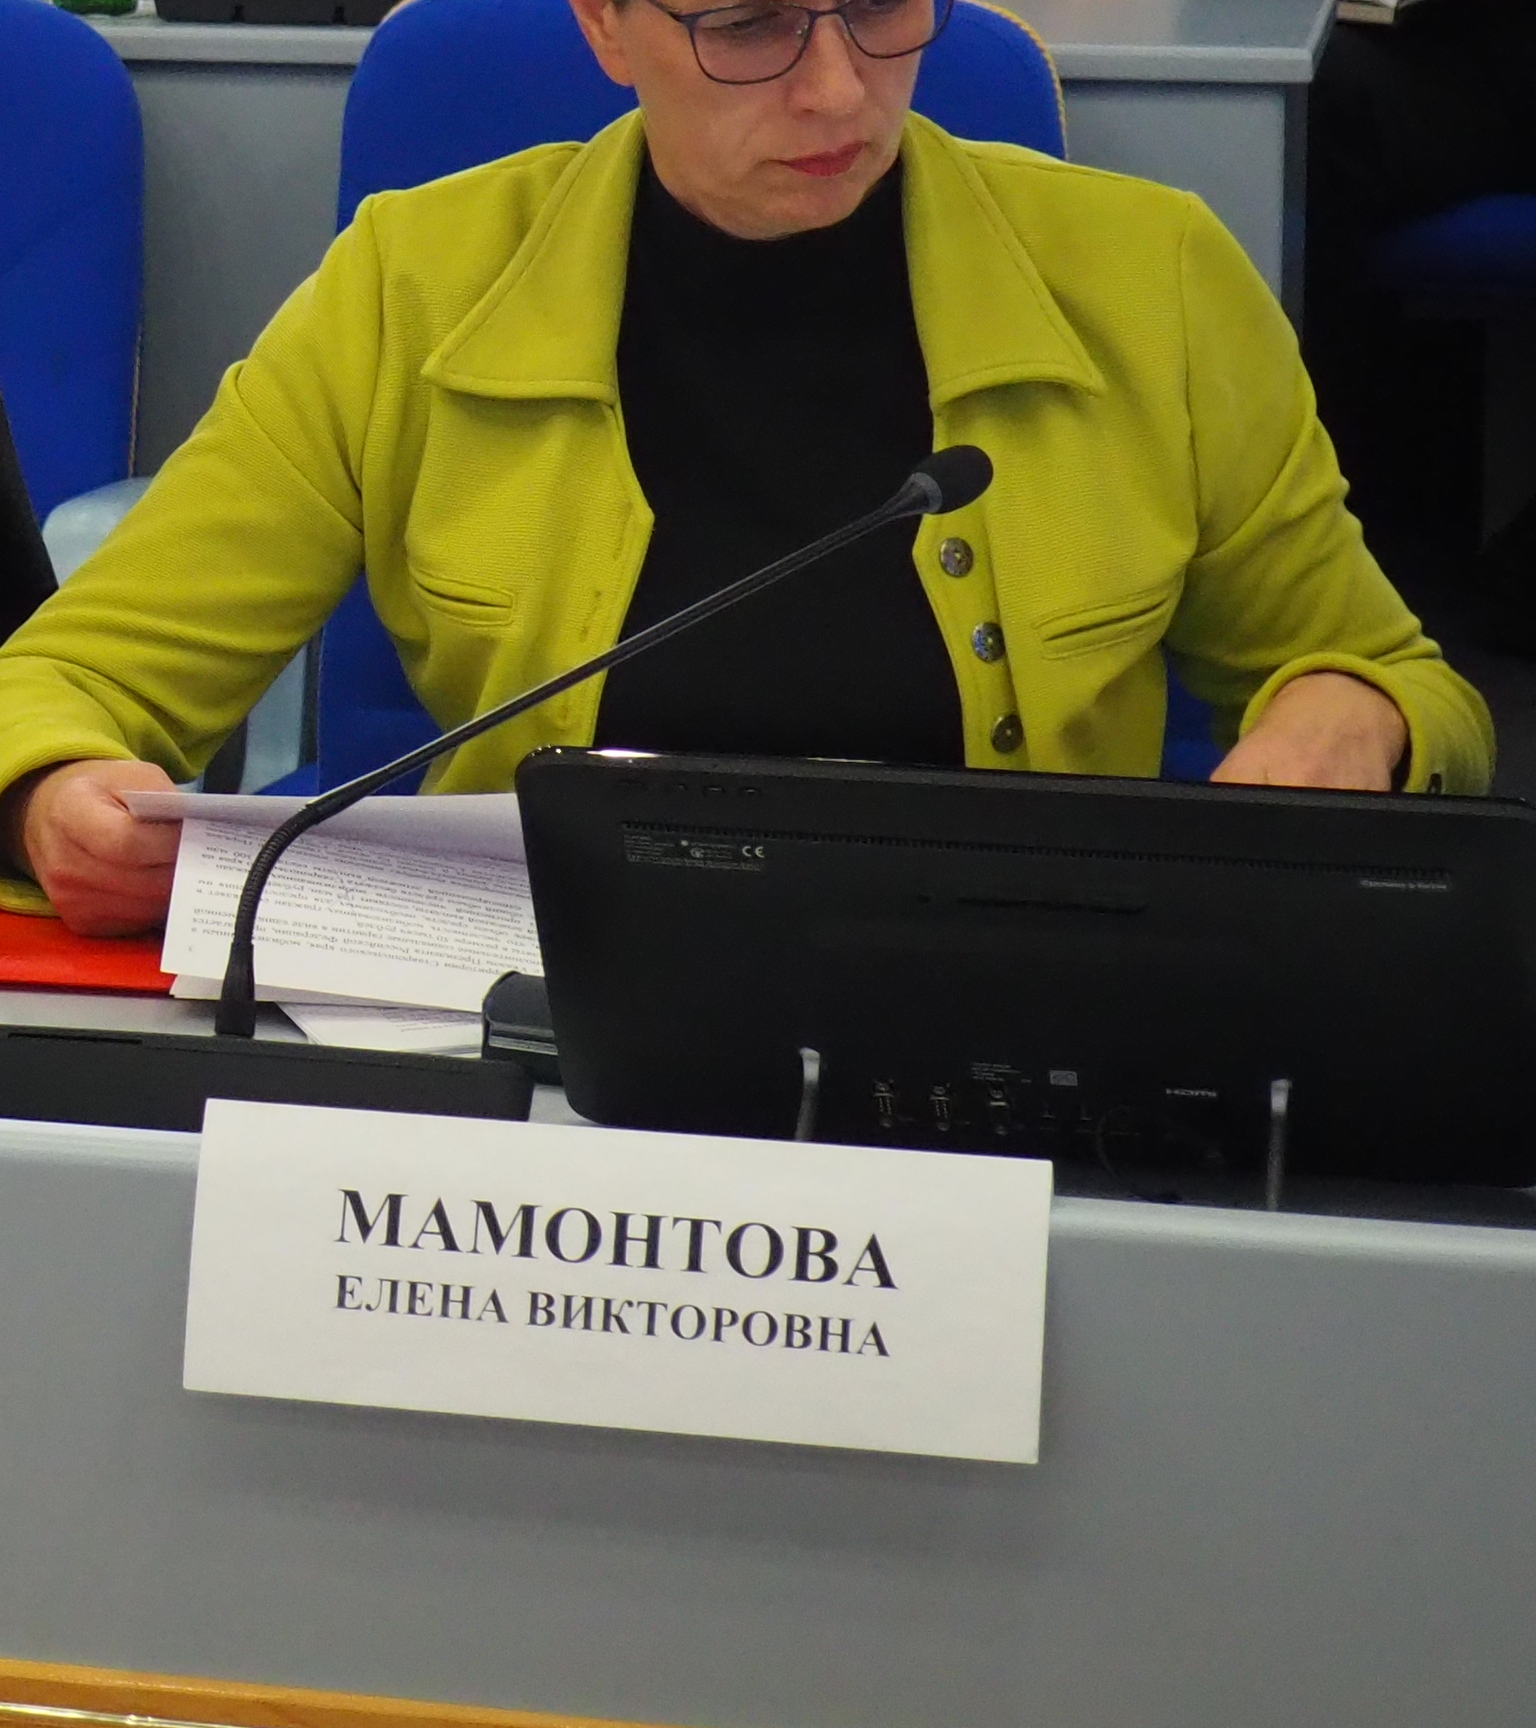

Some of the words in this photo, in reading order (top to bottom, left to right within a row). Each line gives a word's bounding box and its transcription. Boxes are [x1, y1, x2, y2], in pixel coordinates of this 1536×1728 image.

[334, 1188, 899, 1290] МАМОНТОВА
[333, 1274, 509, 1325] ЕЛЕНА
[527, 1290, 892, 1359] ВИКТОРОВНА
